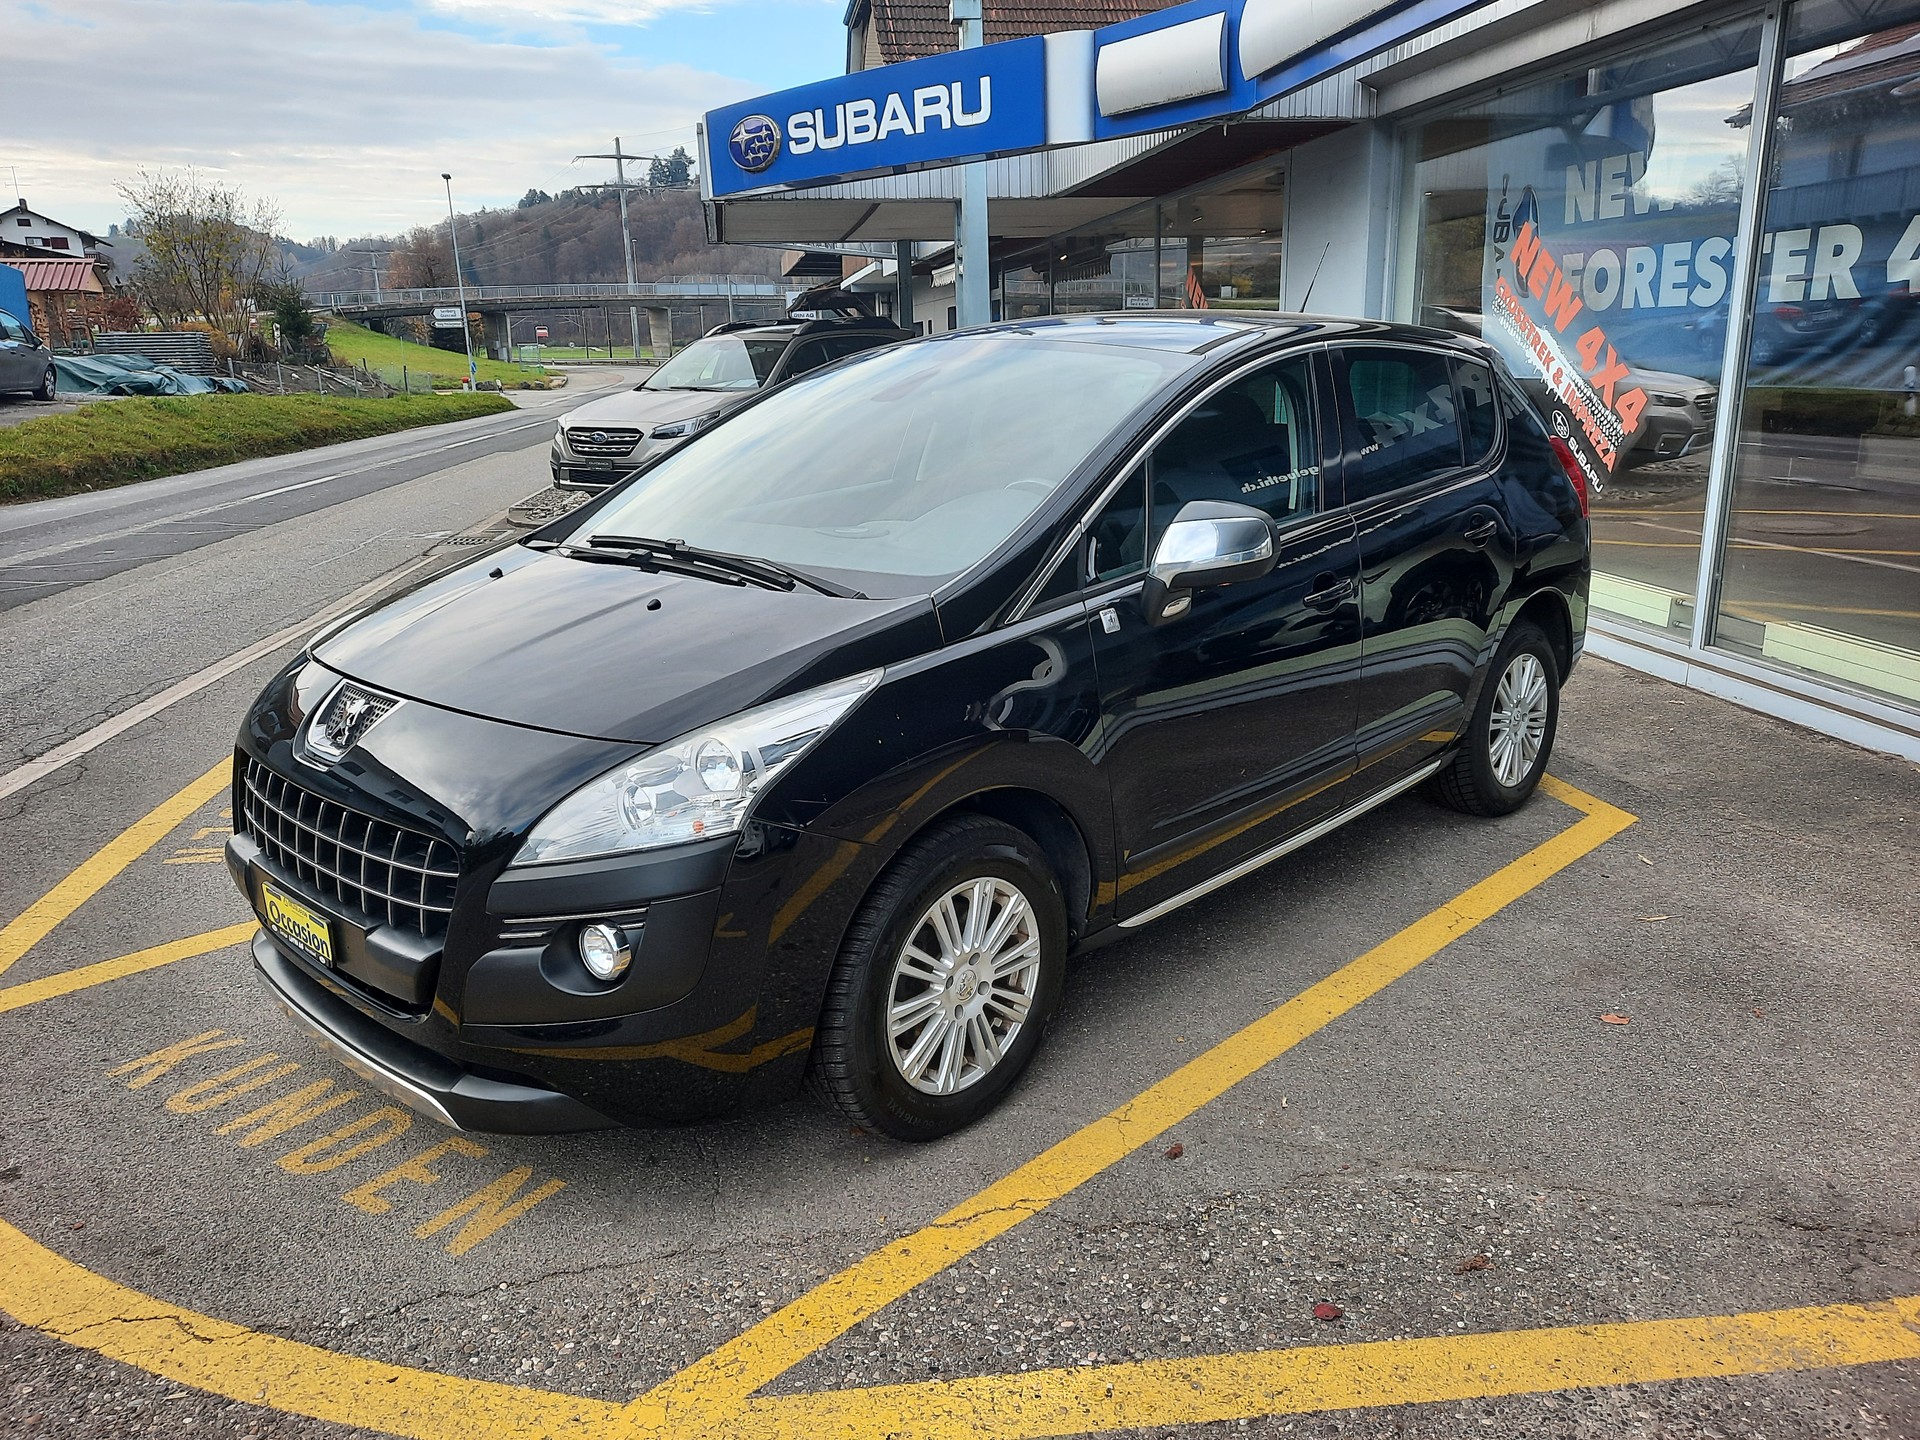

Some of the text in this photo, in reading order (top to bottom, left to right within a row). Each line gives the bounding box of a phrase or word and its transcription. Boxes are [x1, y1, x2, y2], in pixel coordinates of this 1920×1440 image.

[787, 76, 992, 155] SUBARU
[1510, 221, 1649, 436] NEW 4X4
[1552, 367, 1564, 386] &
[1561, 383, 1617, 473] IMPREZA
[1567, 436, 1604, 493] SUBARU
[269, 900, 331, 959] Occasion
[104, 1028, 567, 1257] KUNDEN
